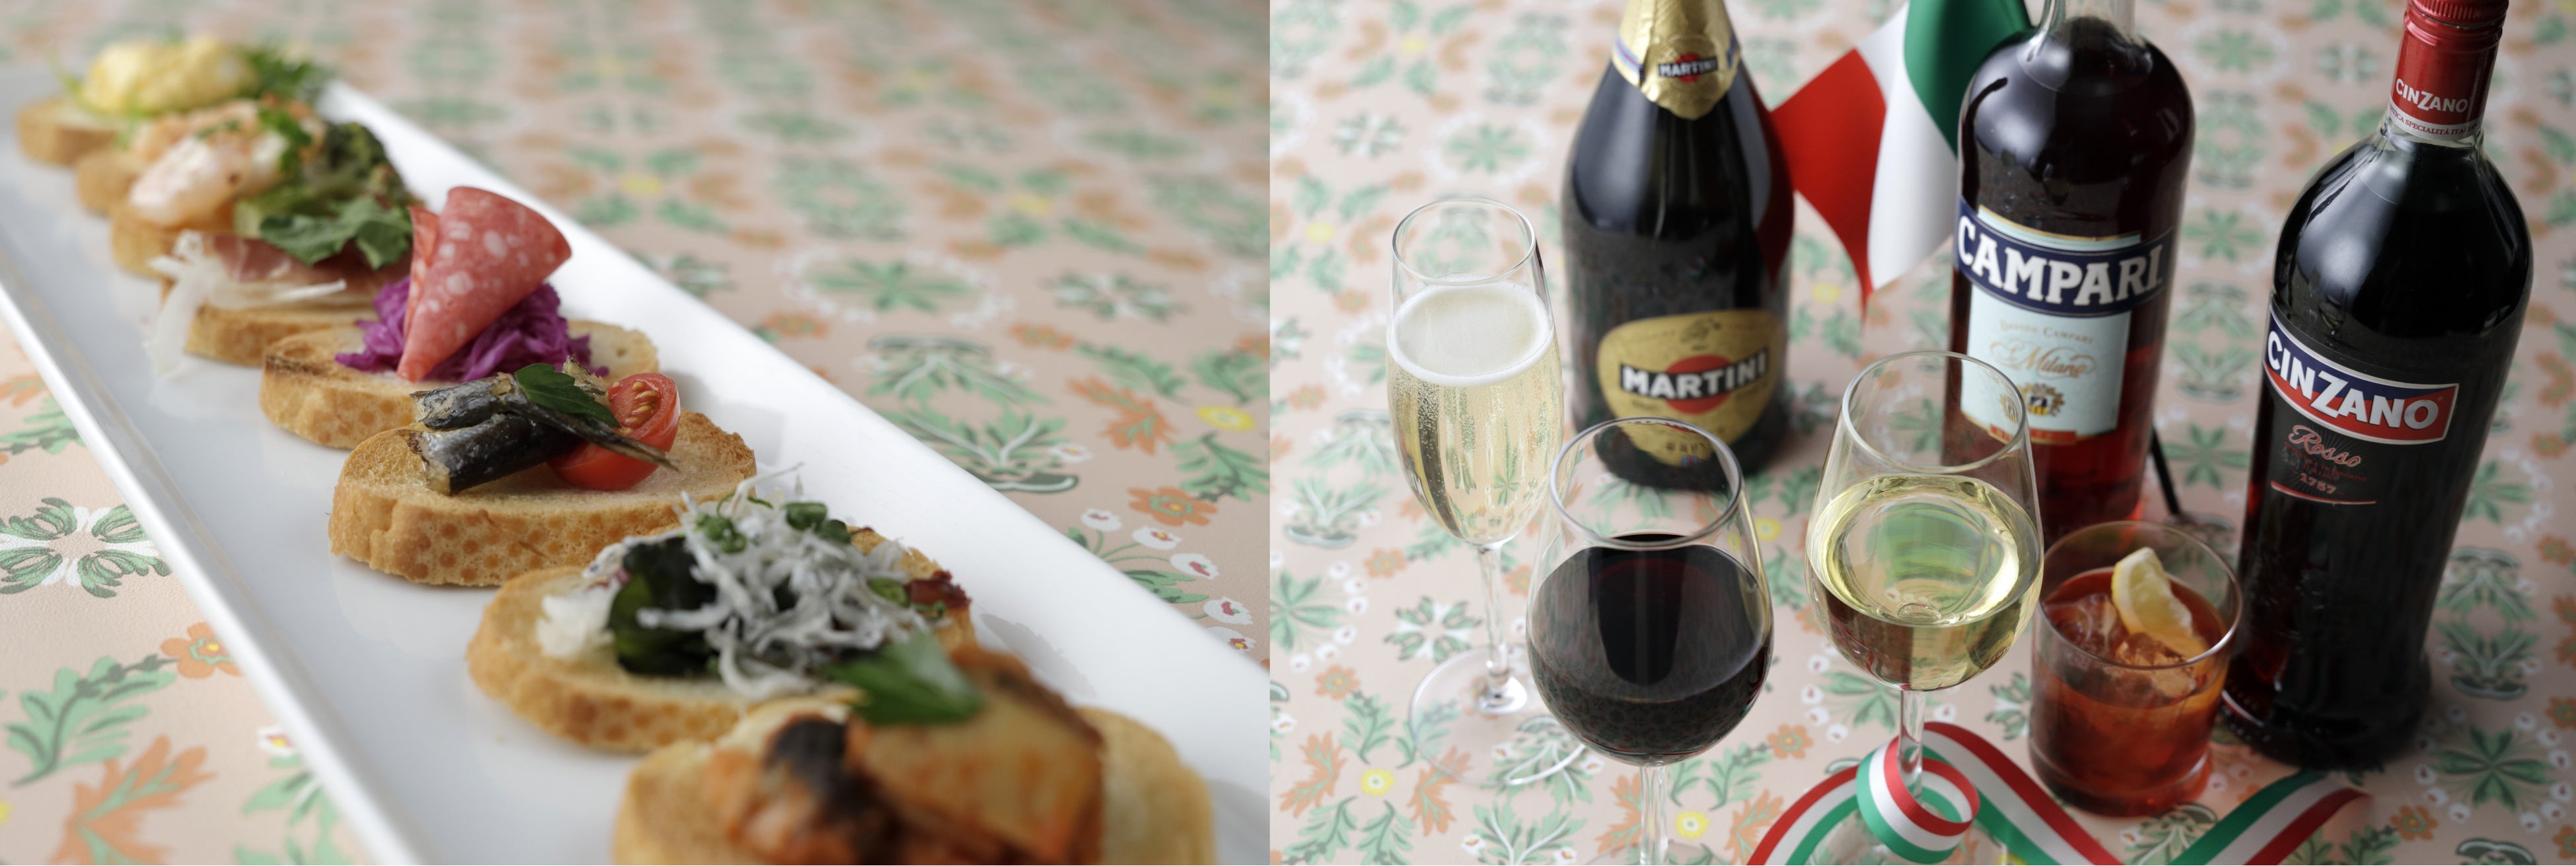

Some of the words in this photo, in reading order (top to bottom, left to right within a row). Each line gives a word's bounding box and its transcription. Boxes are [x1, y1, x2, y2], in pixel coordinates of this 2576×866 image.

[1659, 57, 1716, 76] MARTINI
[2396, 78, 2468, 113] CINZANO
[1958, 215, 2163, 306] CAMPARI
[1622, 349, 1767, 398] MARTINI
[2268, 330, 2439, 429] CINZANO
[2288, 425, 2361, 468] Rosso
